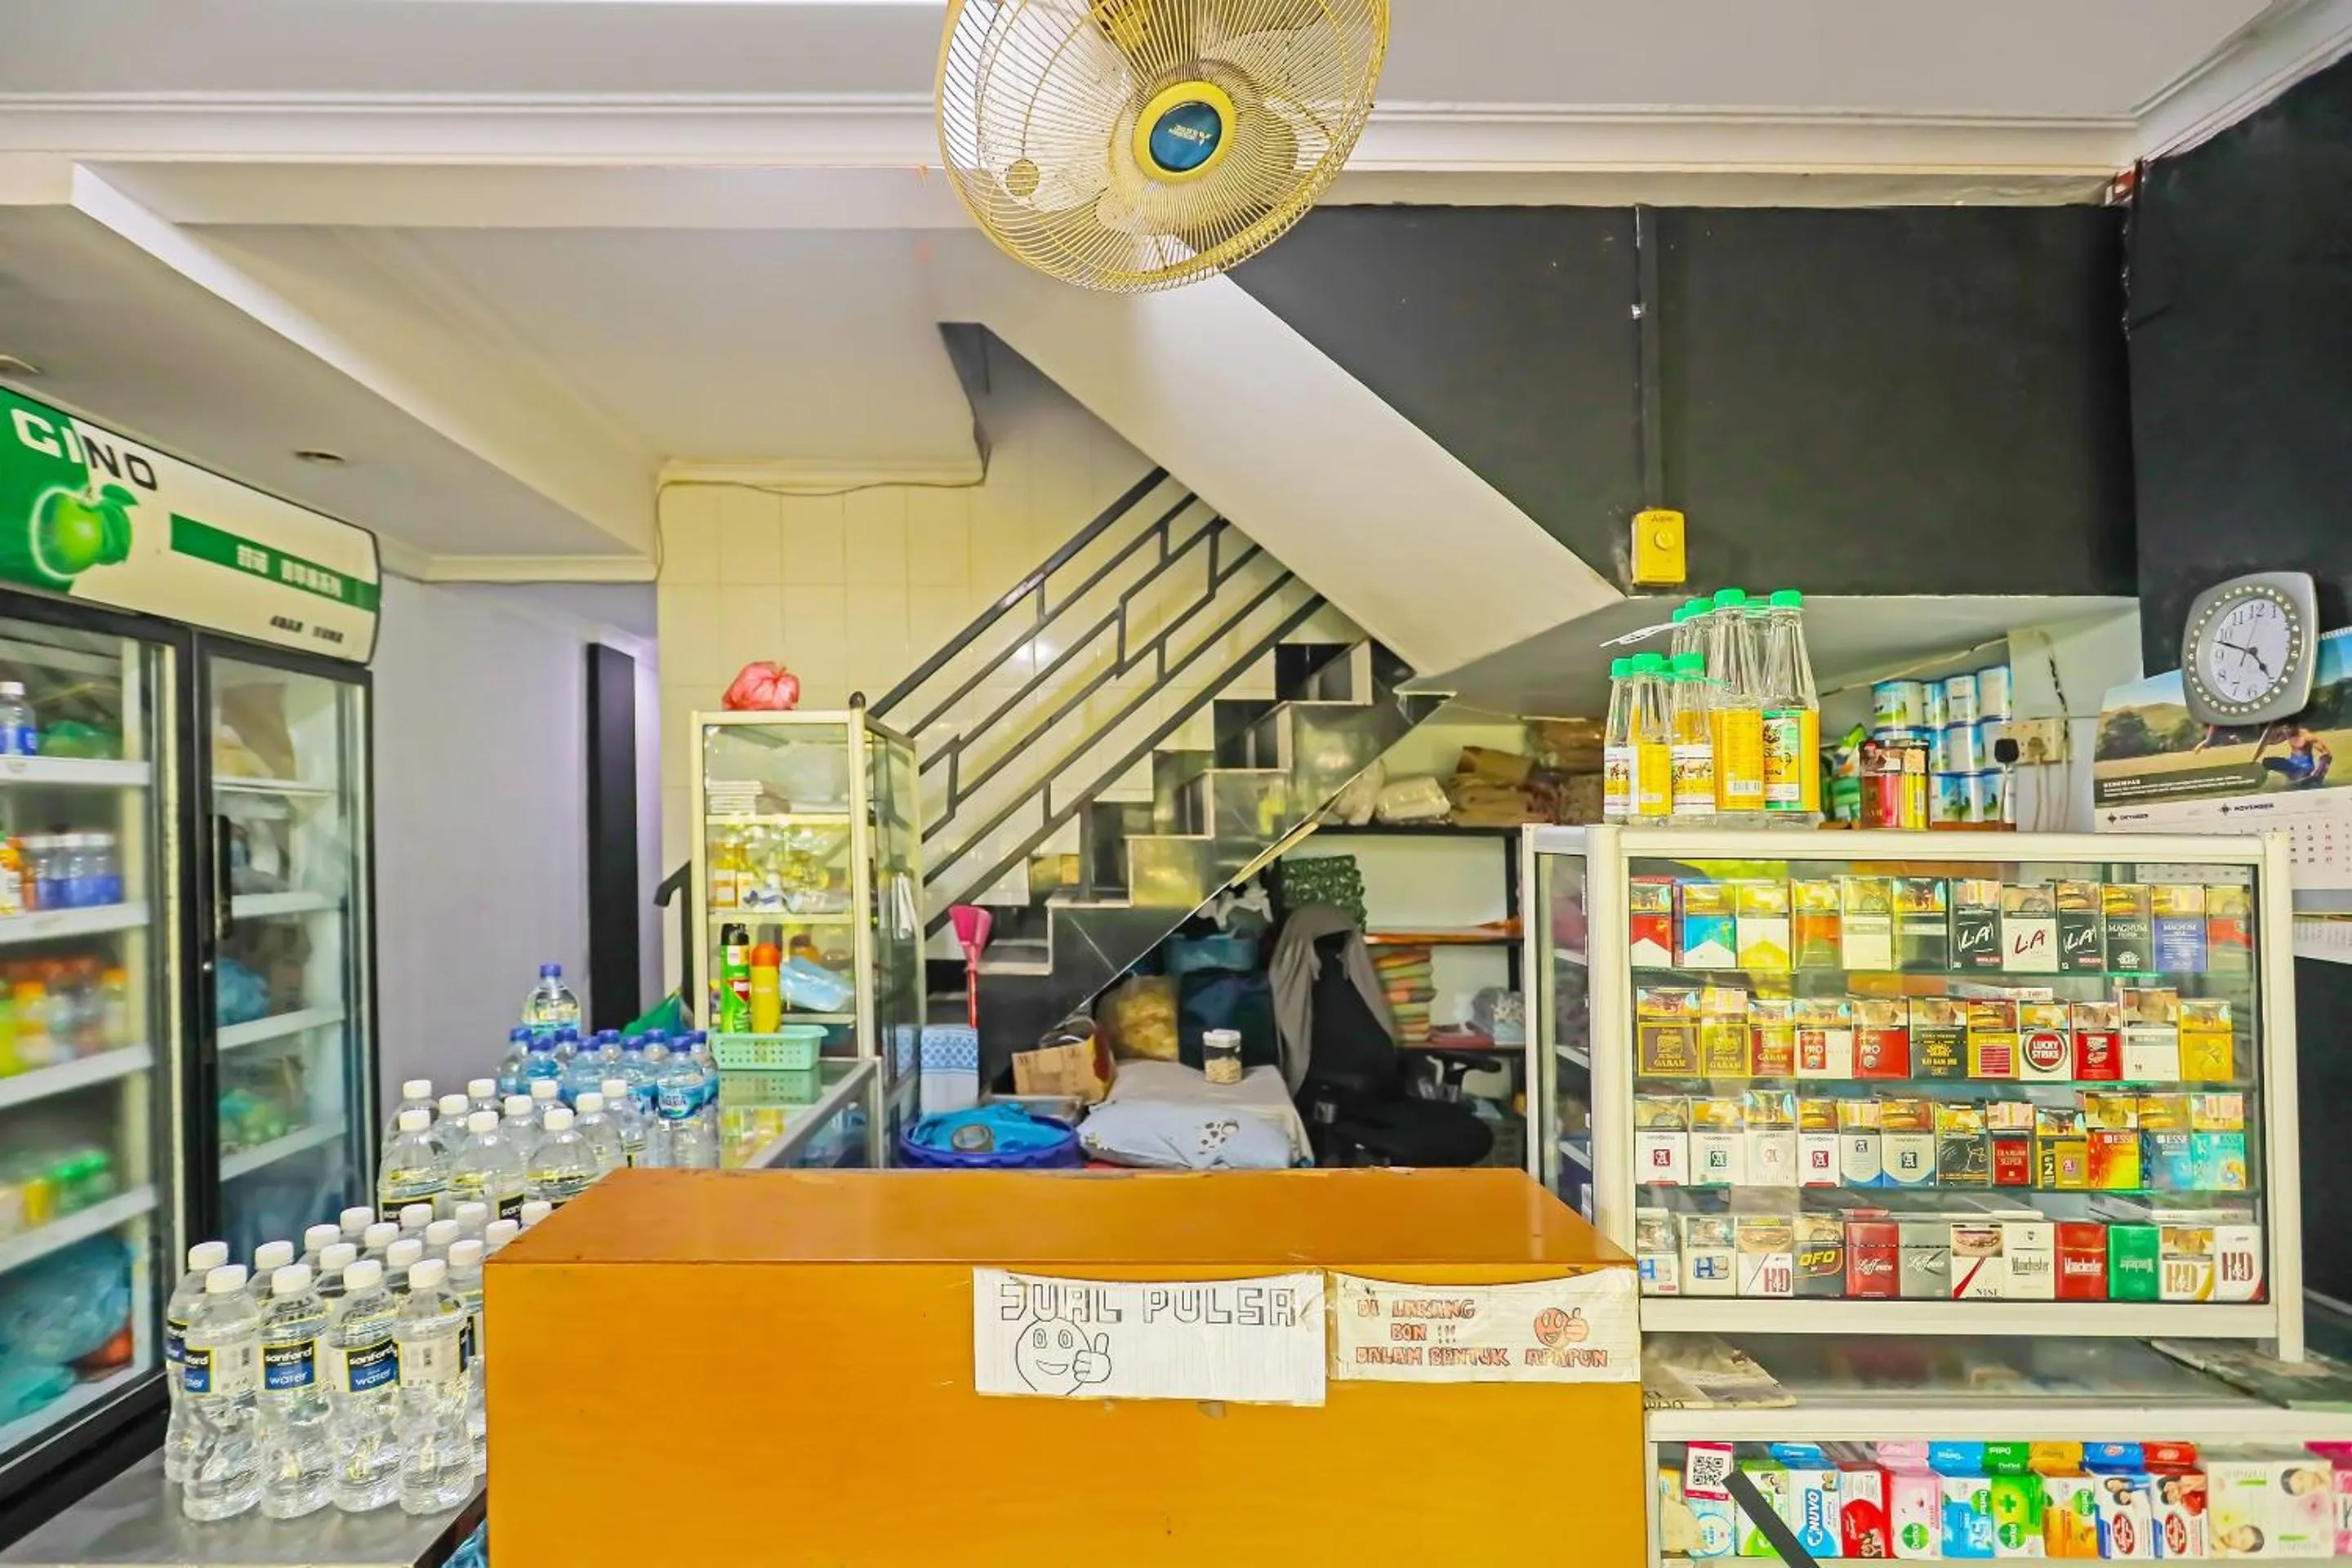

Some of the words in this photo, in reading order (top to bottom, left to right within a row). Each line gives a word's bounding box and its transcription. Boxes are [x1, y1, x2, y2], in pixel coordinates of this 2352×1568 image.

[2249, 603, 2265, 620] 12
[2033, 1040, 2059, 1049] LUCKY
[2031, 1049, 2060, 1059] STRIKE
[2113, 1134, 2134, 1143] ESSE
[2166, 1134, 2188, 1143] ESSE
[1000, 1283, 1123, 1323] JUAL
[1142, 1287, 1296, 1326] PULSA
[1390, 1323, 1428, 1341] BON
[265, 1347, 313, 1362] sanford
[1356, 1347, 1423, 1365] DALAM
[1428, 1348, 1511, 1366] BENTUK
[1525, 1348, 1608, 1368] APAPUN
[269, 1371, 308, 1385] water
[355, 1367, 391, 1385] water
[1806, 1490, 1820, 1531] NUVO
[1979, 1490, 1988, 1517] Dettol
[2080, 1490, 2090, 1516] Dettol
